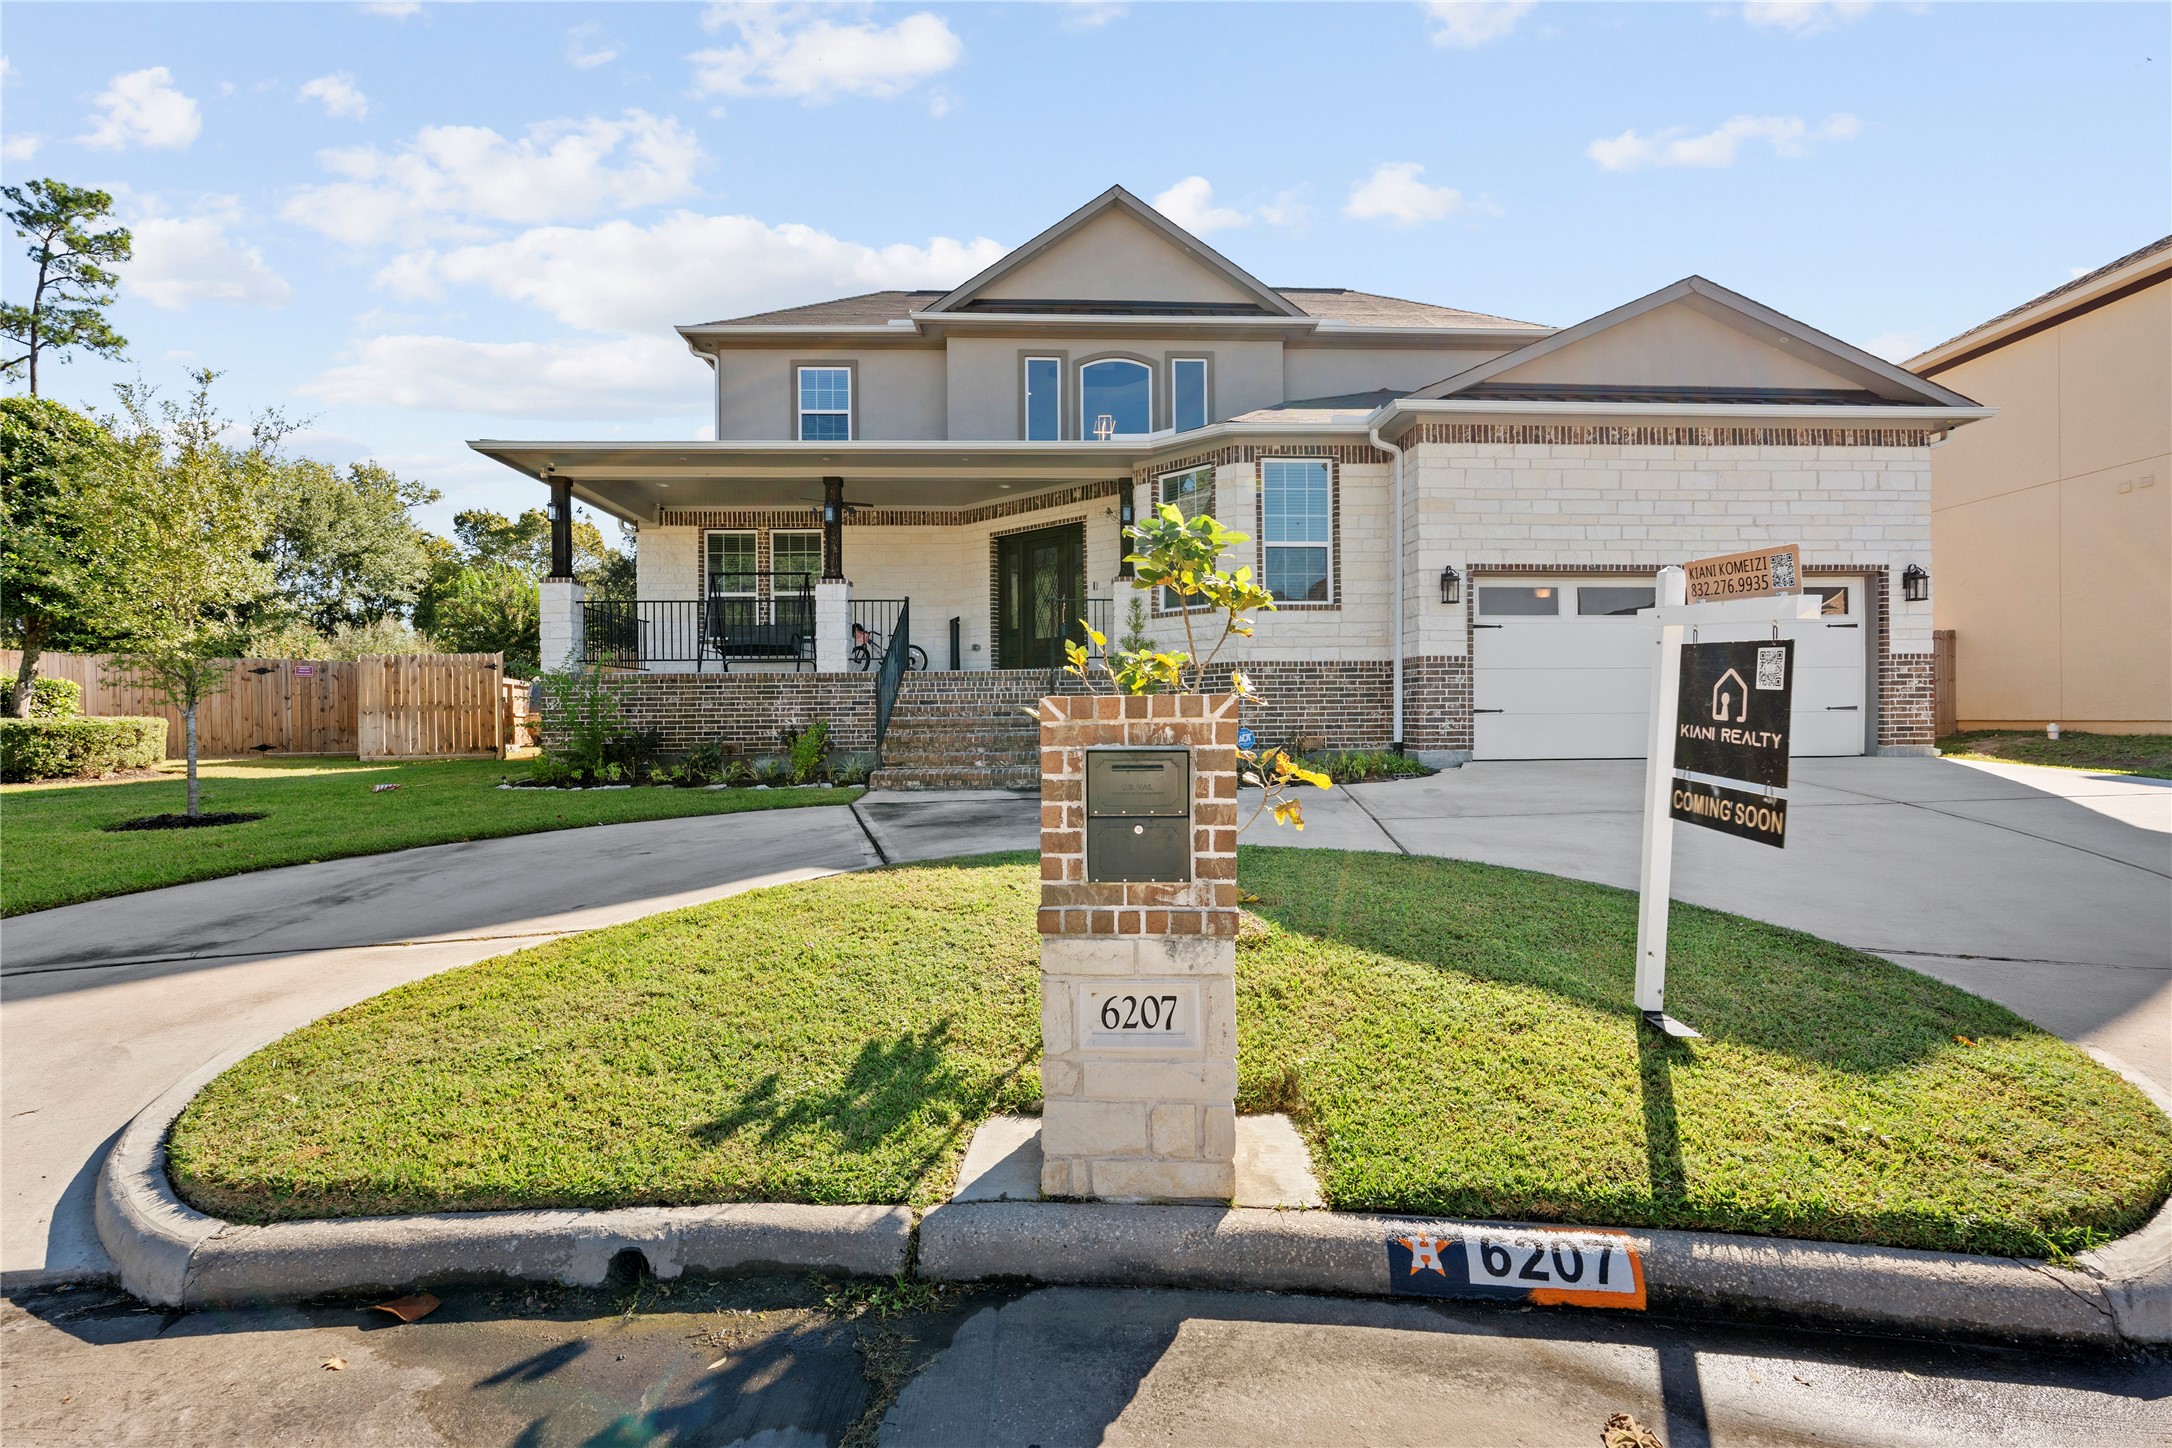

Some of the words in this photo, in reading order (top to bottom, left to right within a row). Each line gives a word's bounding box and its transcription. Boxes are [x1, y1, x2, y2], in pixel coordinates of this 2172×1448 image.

[1688, 564, 1717, 580] KIANI
[1719, 556, 1768, 575] KOMEIZI
[1691, 574, 1769, 597] 832.276.9935
[1239, 733, 1252, 742] ADT
[1680, 723, 1715, 741] KIANI
[1721, 729, 1782, 749] REALTY
[1673, 790, 1732, 821] COMING
[1735, 803, 1784, 835] SOON
[1101, 995, 1177, 1030] 6207
[1480, 1236, 1614, 1284] 6207
